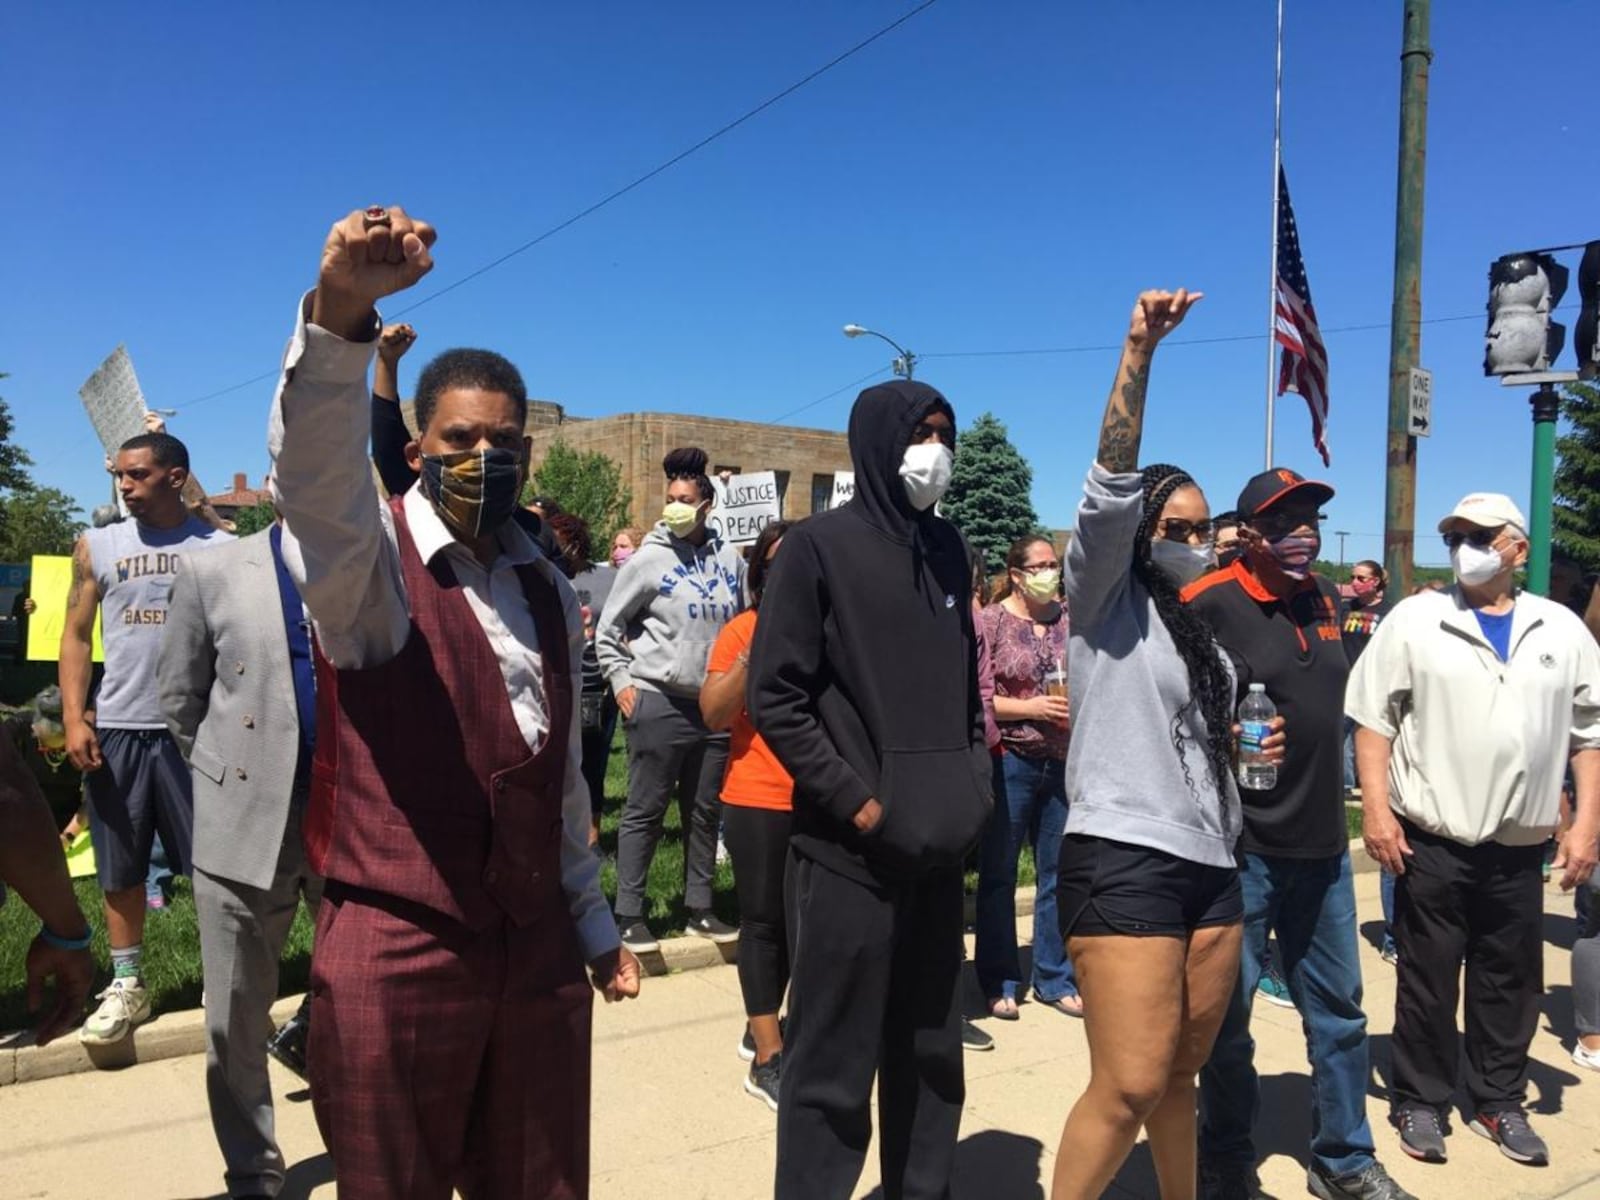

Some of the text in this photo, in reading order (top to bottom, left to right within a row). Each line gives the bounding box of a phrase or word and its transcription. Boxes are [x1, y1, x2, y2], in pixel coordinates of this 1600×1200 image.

[1412, 374, 1430, 393] ONE
[1412, 394, 1429, 414] WAY
[722, 483, 775, 505] JUSTICE
[688, 603, 729, 621] CITY
